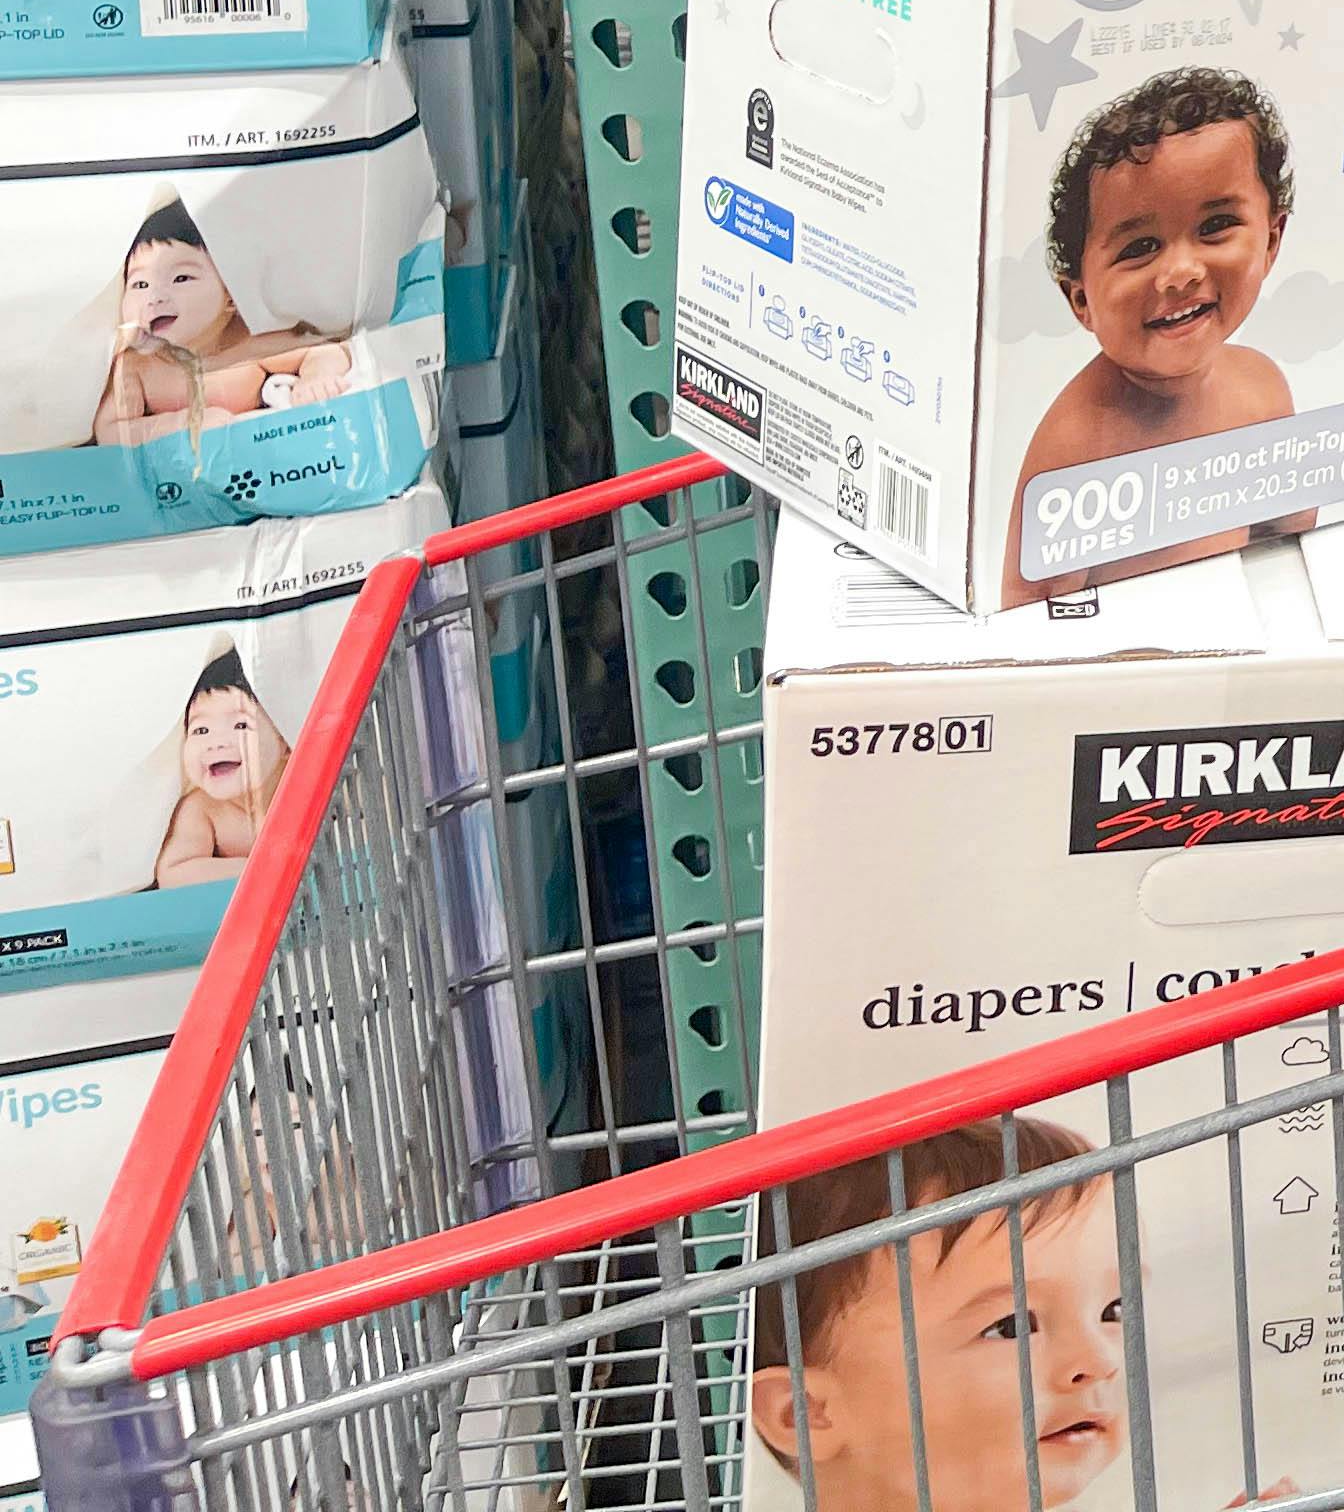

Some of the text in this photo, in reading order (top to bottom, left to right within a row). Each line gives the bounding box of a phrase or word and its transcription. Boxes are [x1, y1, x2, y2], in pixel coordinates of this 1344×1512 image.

[1165, 466, 1179, 490] 9
[1184, 466, 1197, 486] x
[1202, 451, 1242, 481] 100
[1244, 446, 1267, 470] ct
[1036, 470, 1144, 539] 900
[1040, 527, 1136, 566] WIPES
[860, 968, 1106, 1035] diapers
